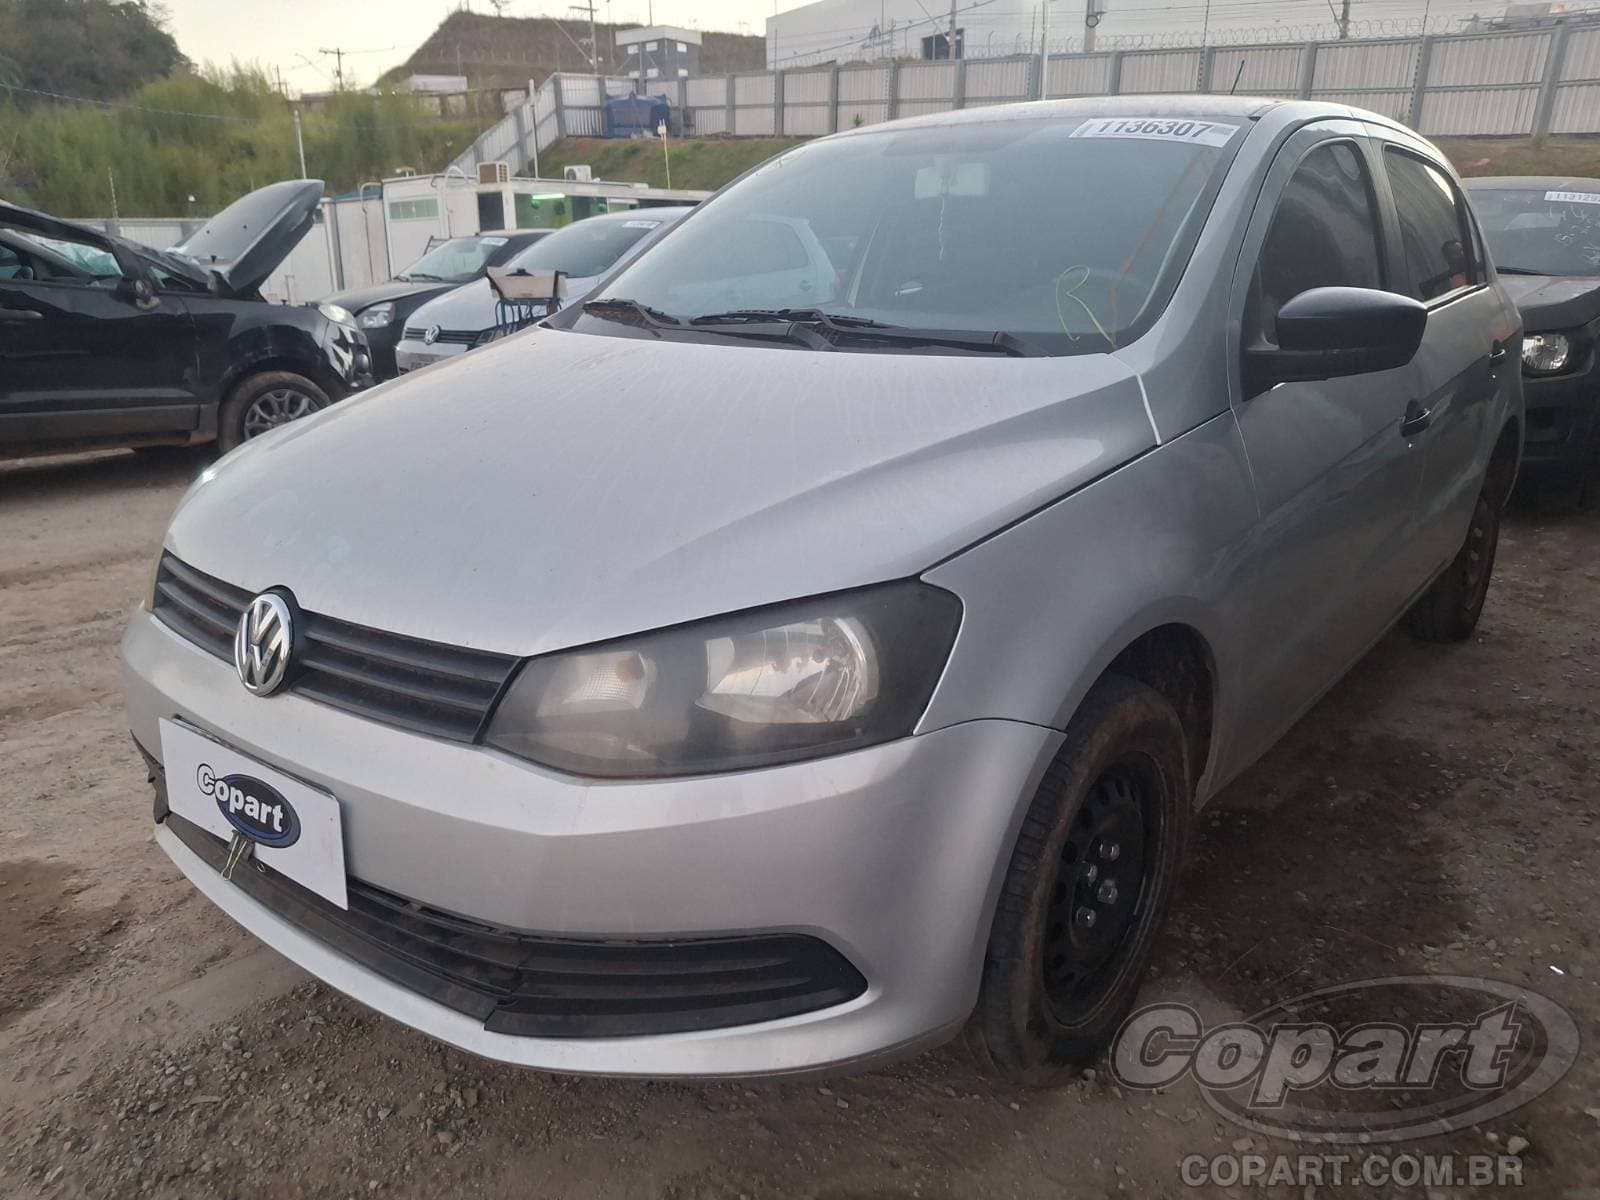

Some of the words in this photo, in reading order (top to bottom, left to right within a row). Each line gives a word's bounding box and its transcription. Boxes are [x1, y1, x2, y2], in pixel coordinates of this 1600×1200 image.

[1098, 120, 1210, 138] 1136307
[235, 593, 292, 697] VW
[197, 763, 284, 832] Copart
